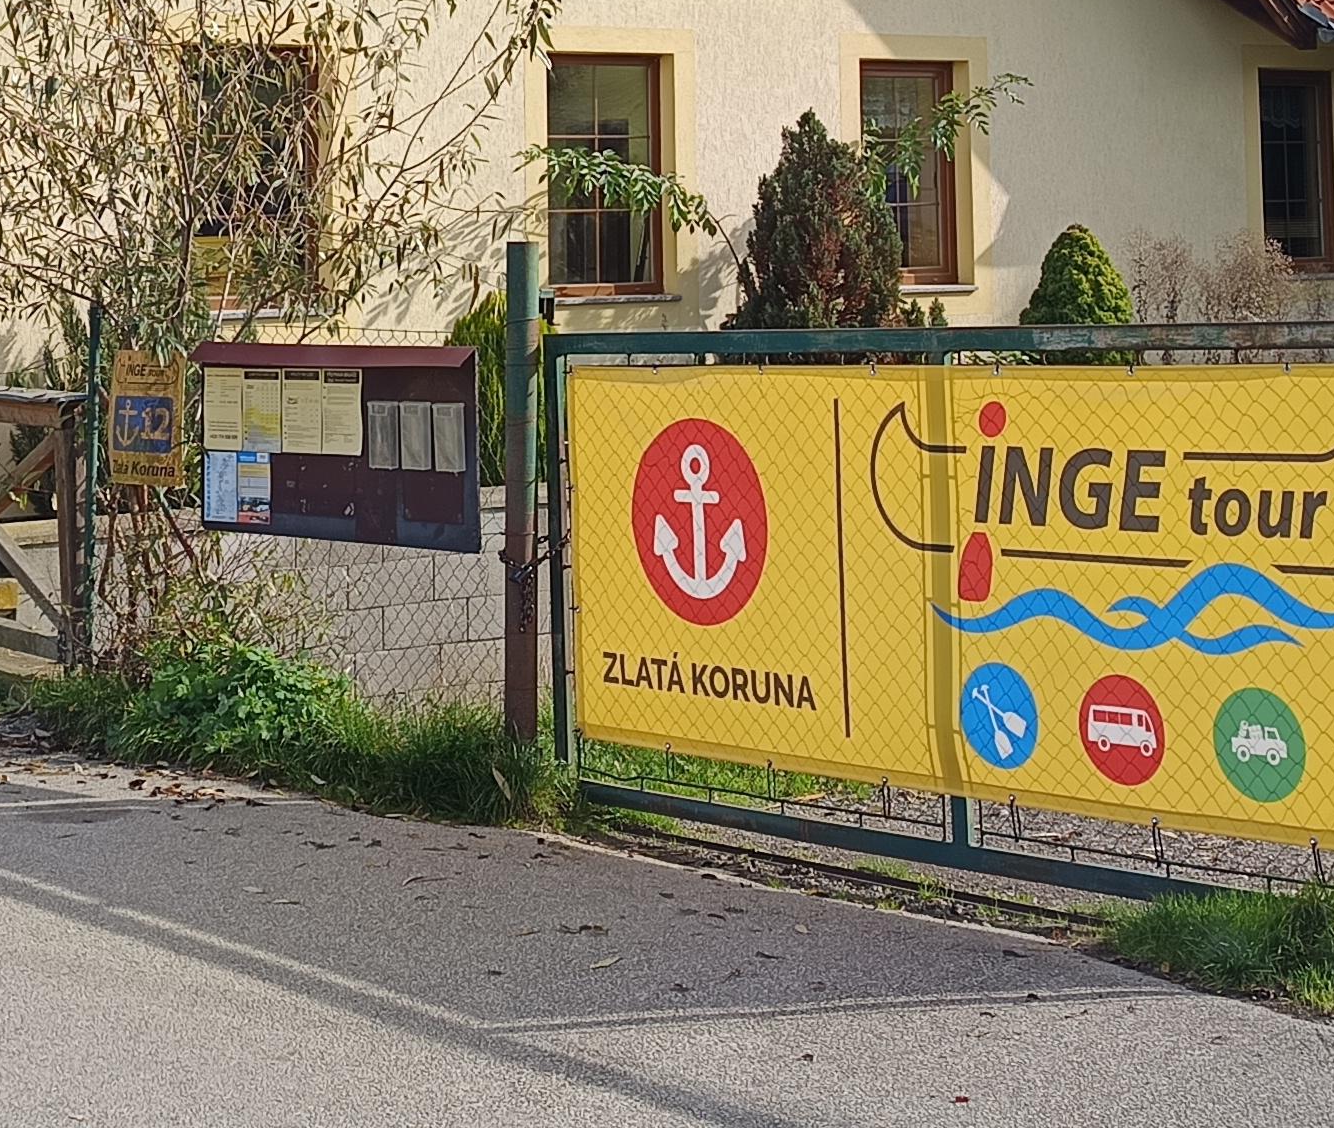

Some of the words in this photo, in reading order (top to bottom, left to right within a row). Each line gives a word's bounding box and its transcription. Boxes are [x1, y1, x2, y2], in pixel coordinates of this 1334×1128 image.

[141, 407, 170, 441] 12
[131, 461, 176, 477] Koruna
[1187, 475, 1328, 540] tour
[602, 651, 686, 694] ZLATÁ
[690, 662, 817, 711] KORUNA
